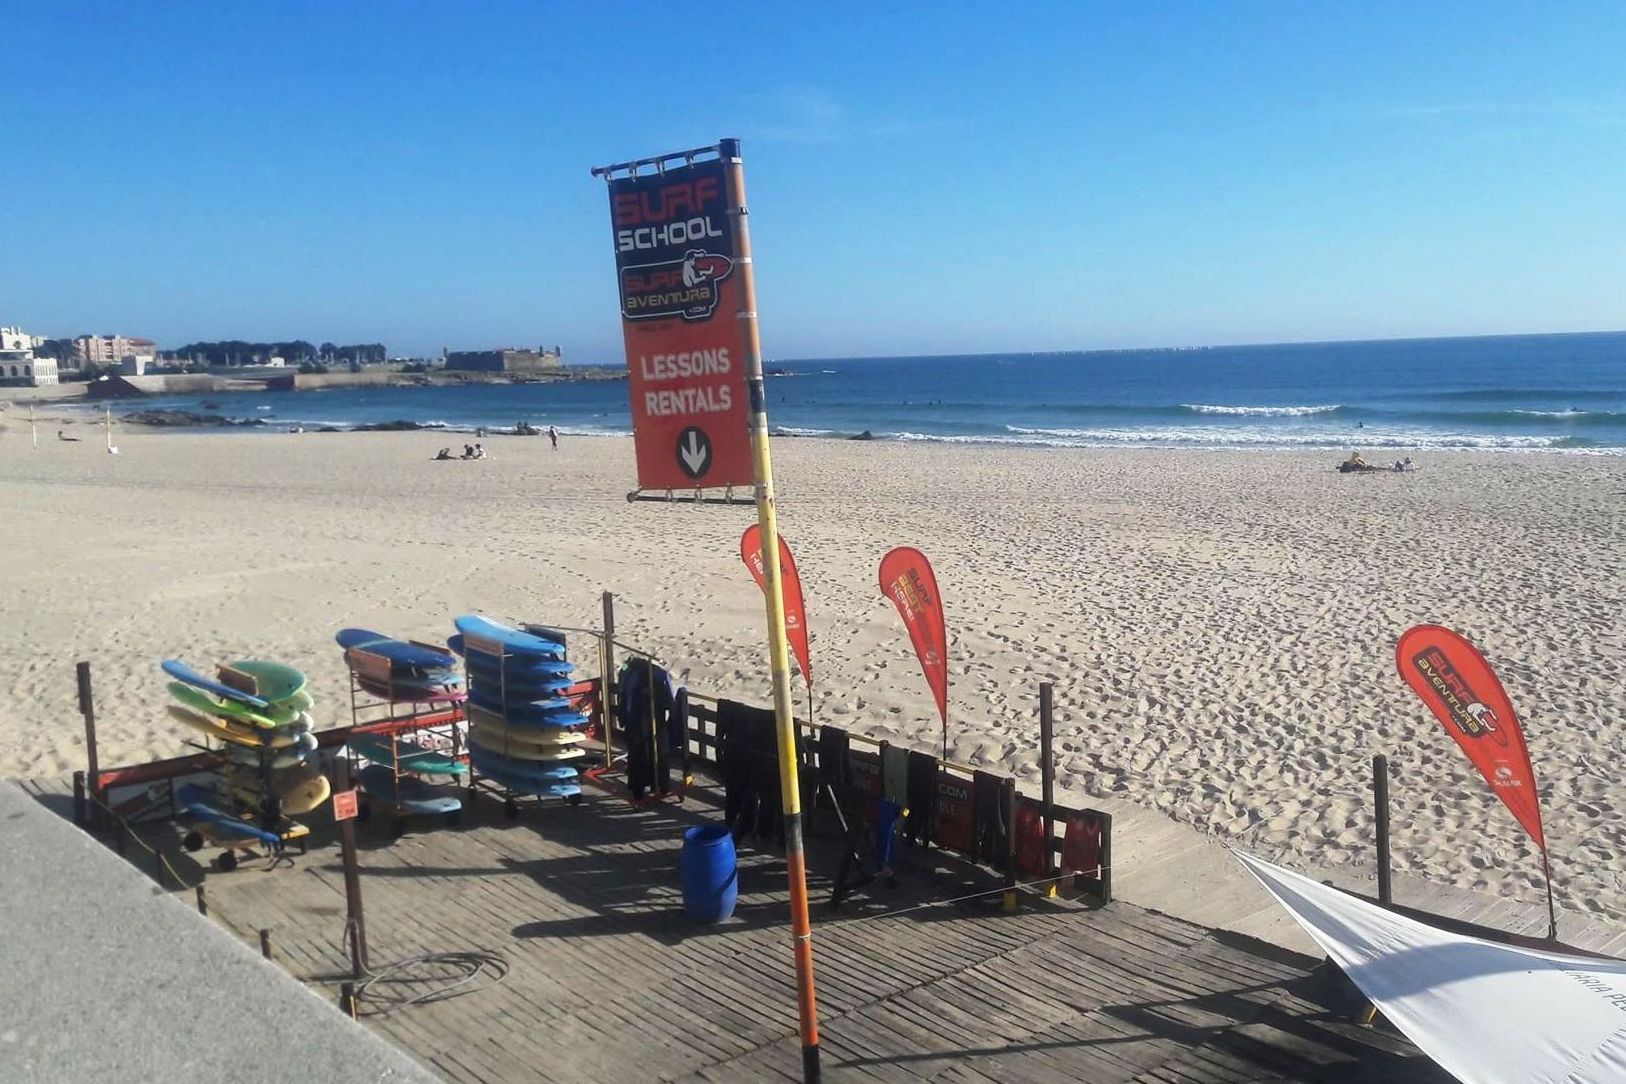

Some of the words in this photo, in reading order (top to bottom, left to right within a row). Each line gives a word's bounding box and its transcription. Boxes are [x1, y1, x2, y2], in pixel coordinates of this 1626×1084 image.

[615, 177, 719, 225] SURF
[618, 216, 723, 251] SCHOOL
[625, 270, 684, 292] SURF
[640, 347, 731, 381] LESSONS
[645, 384, 732, 416] RENTALS
[1426, 651, 1474, 705] SURF
